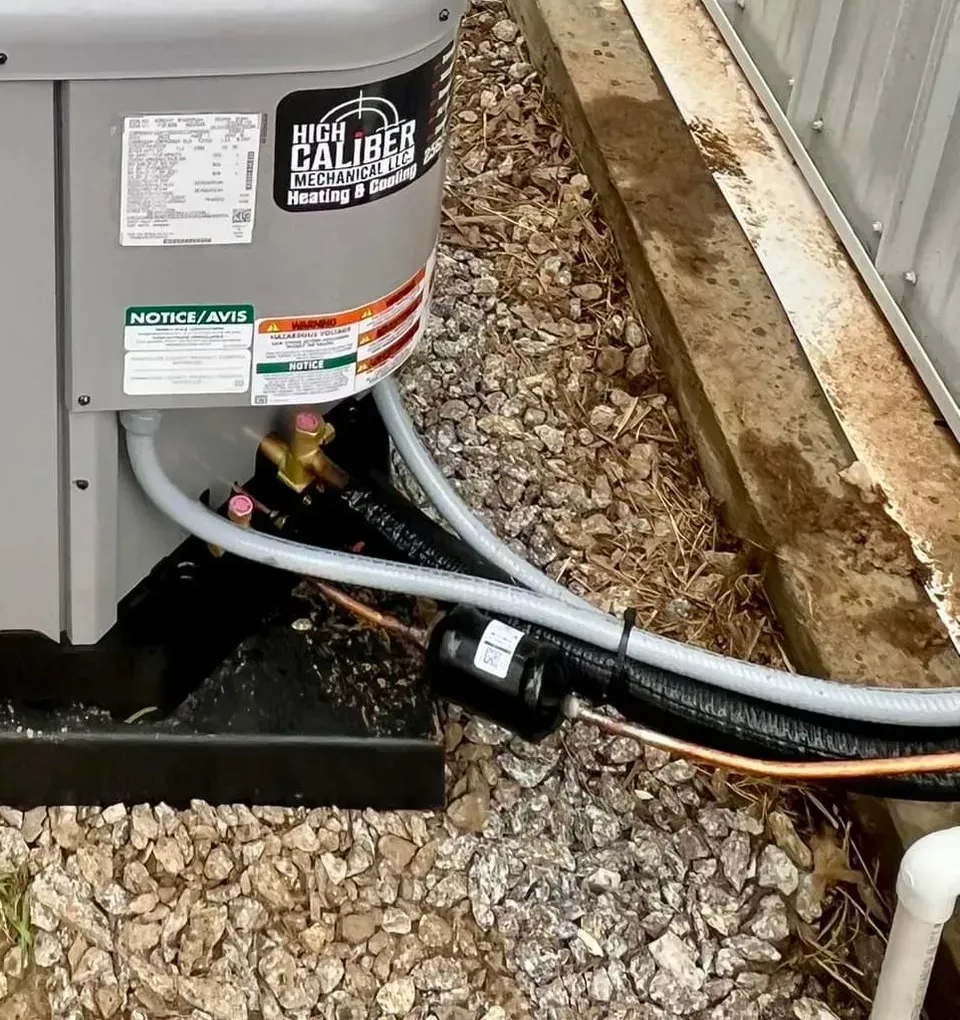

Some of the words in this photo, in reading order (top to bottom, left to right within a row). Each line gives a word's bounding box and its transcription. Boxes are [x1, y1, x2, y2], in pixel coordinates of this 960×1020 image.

[292, 121, 346, 144] HIGH
[294, 164, 384, 187] MECHANICAL
[387, 150, 411, 171] LLC
[286, 188, 350, 206] Heating
[353, 183, 365, 199] &
[368, 162, 418, 195] Cooling
[129, 310, 248, 324] NOTICE/AVIS
[291, 318, 337, 331] WARNING
[289, 359, 325, 371] NOTICE
